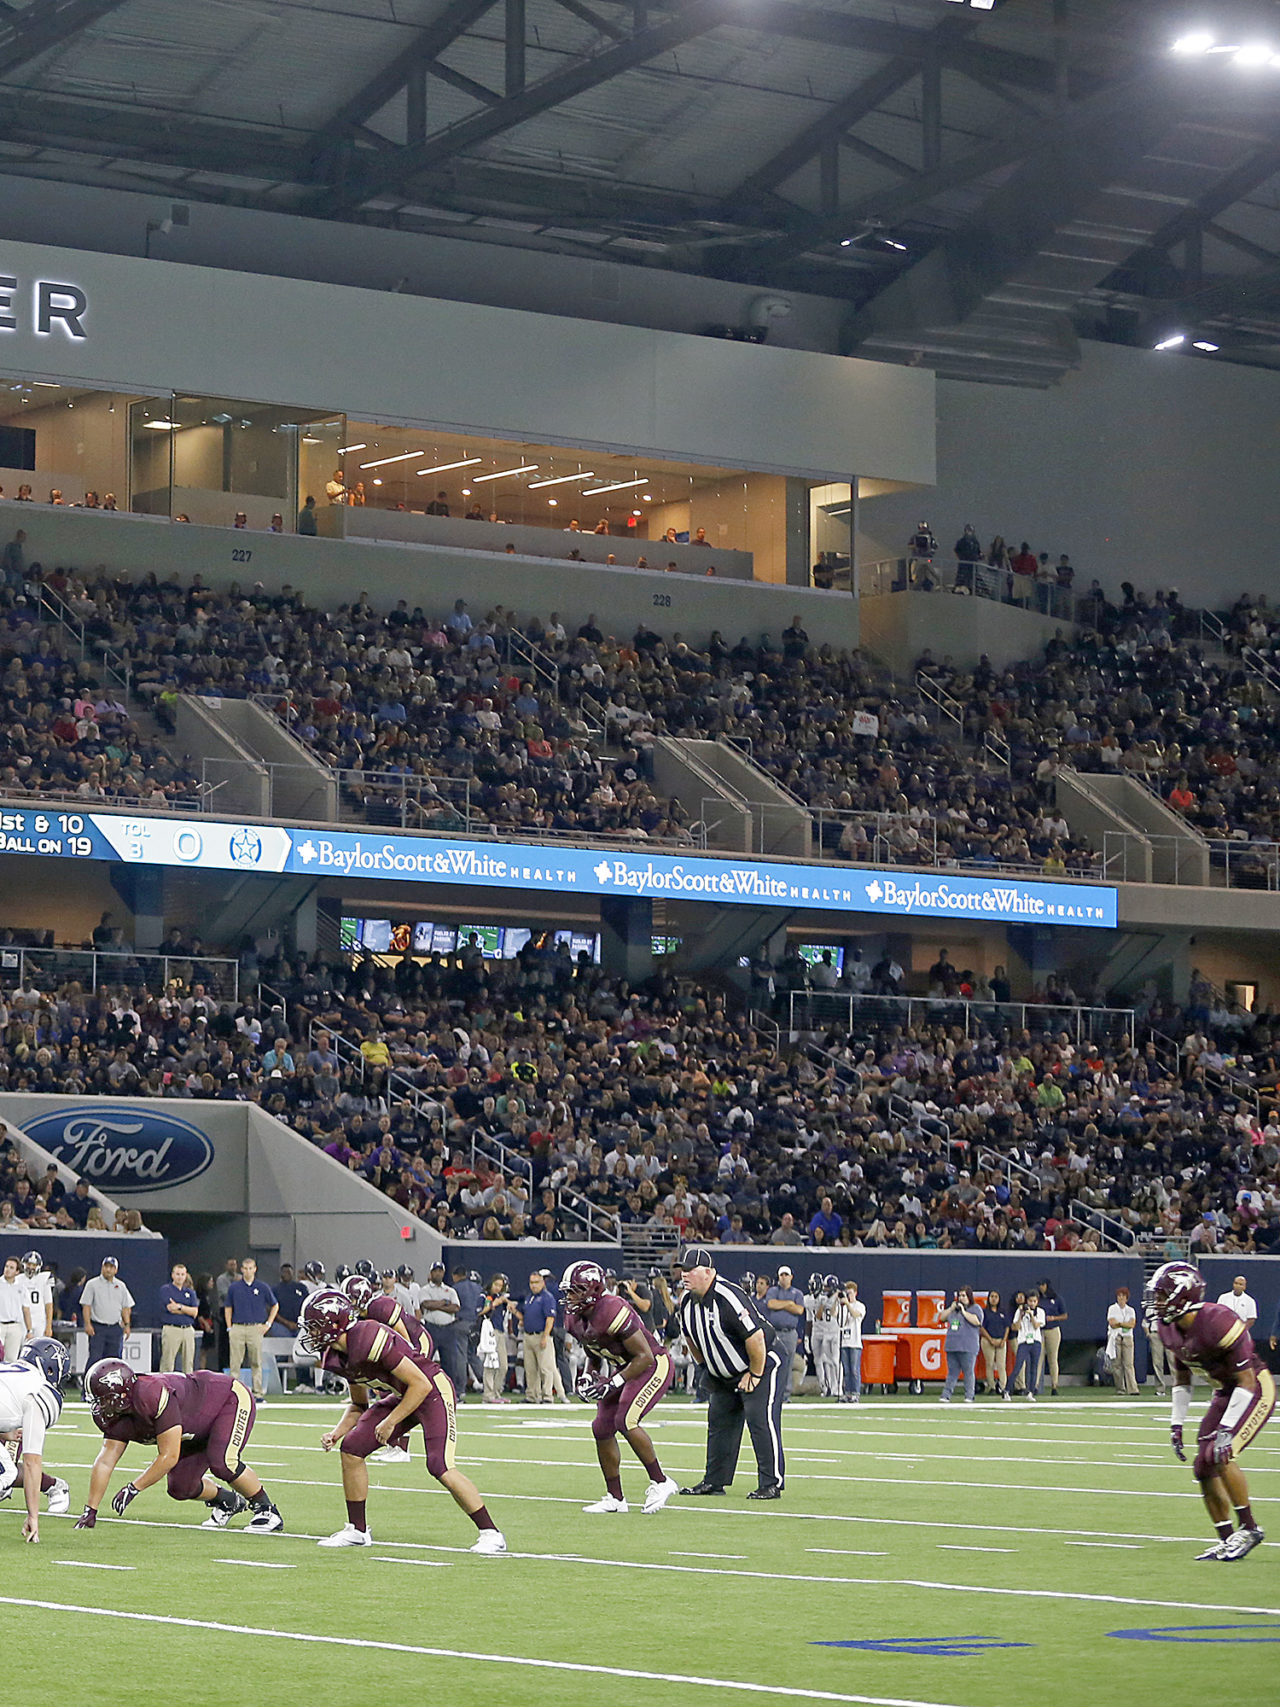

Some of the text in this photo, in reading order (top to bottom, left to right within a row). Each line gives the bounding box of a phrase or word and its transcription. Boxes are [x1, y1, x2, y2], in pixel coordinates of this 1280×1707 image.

[232, 549, 252, 562] 227
[34, 815, 50, 834] &
[58, 814, 84, 835] 10
[121, 823, 151, 838] TOL
[69, 836, 92, 857] 19
[129, 841, 144, 859] 3
[510, 866, 577, 883] HEALTH
[790, 886, 852, 902] HEALTH
[1047, 903, 1105, 919] HEALTH
[51, 1118, 174, 1178] Ford
[920, 1338, 941, 1371] G
[635, 1376, 662, 1408] COYOTES
[232, 1408, 248, 1447] COYOTES
[1239, 1402, 1269, 1442] COYOTES
